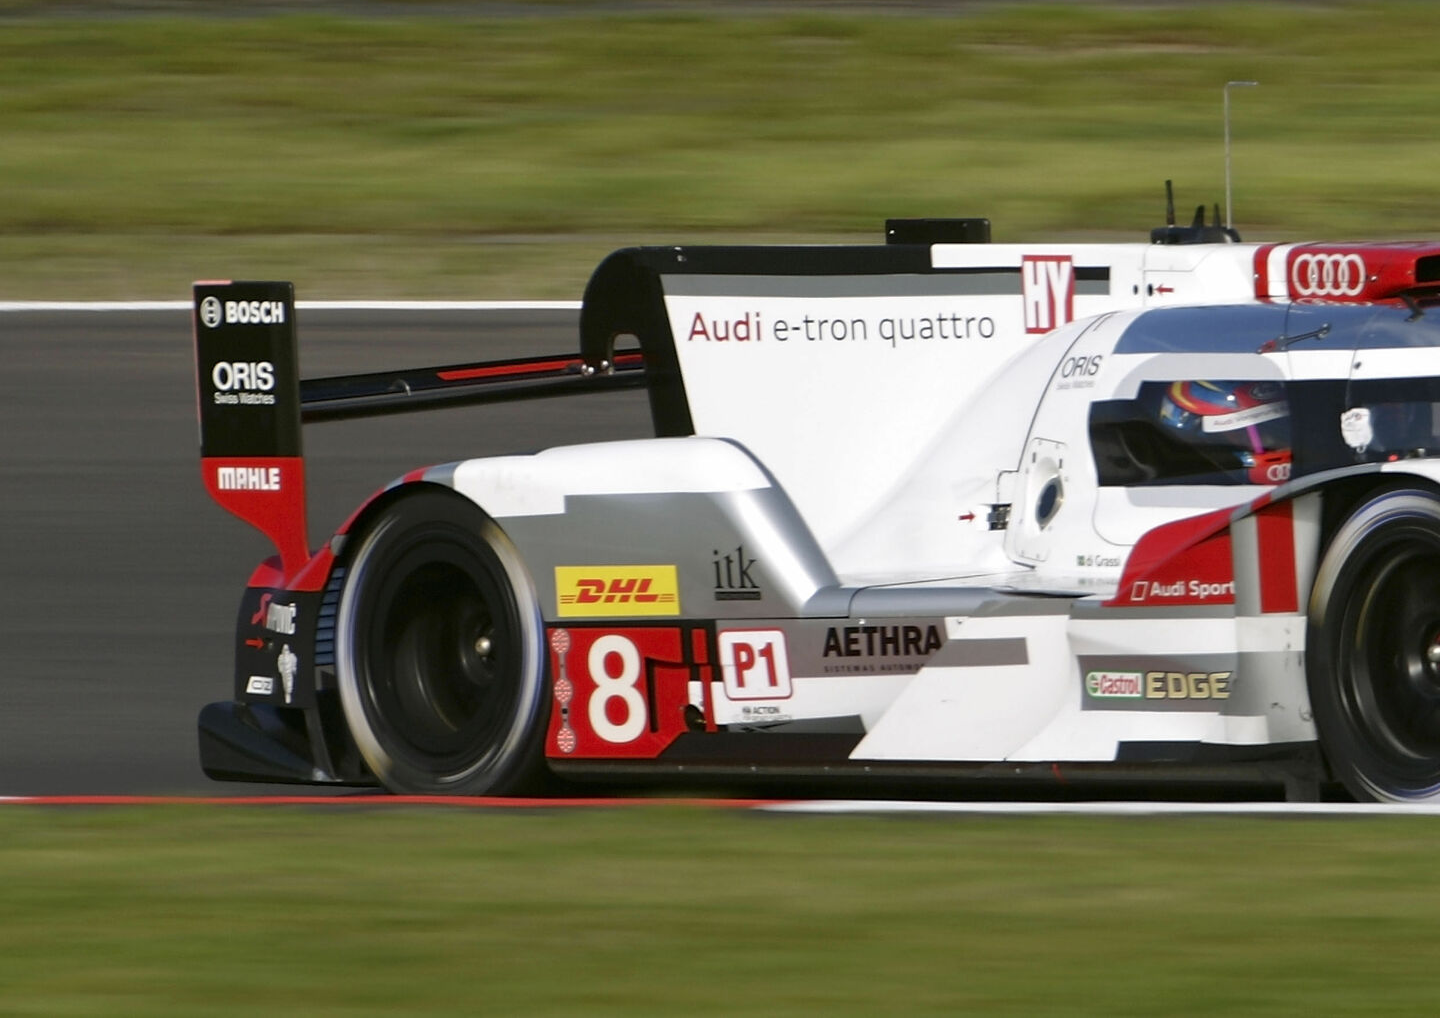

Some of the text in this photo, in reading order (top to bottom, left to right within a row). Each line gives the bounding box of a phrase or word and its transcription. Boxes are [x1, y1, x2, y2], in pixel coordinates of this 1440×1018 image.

[1023, 259, 1073, 330] HY
[225, 301, 285, 323] BOSCH
[688, 312, 996, 348] Audi e-tron quattro
[212, 361, 275, 391] ORIS
[1062, 355, 1103, 378] ORIS
[214, 391, 275, 405] Swiss Watches
[217, 467, 280, 490] MAHLE
[712, 545, 761, 590] itk
[575, 578, 659, 604] DHL
[1150, 581, 1236, 599] Audi Sport
[823, 625, 943, 657] AETHRA
[731, 641, 779, 689] P1
[587, 634, 648, 744] 8
[1100, 672, 1233, 700] Castrol EDGE
